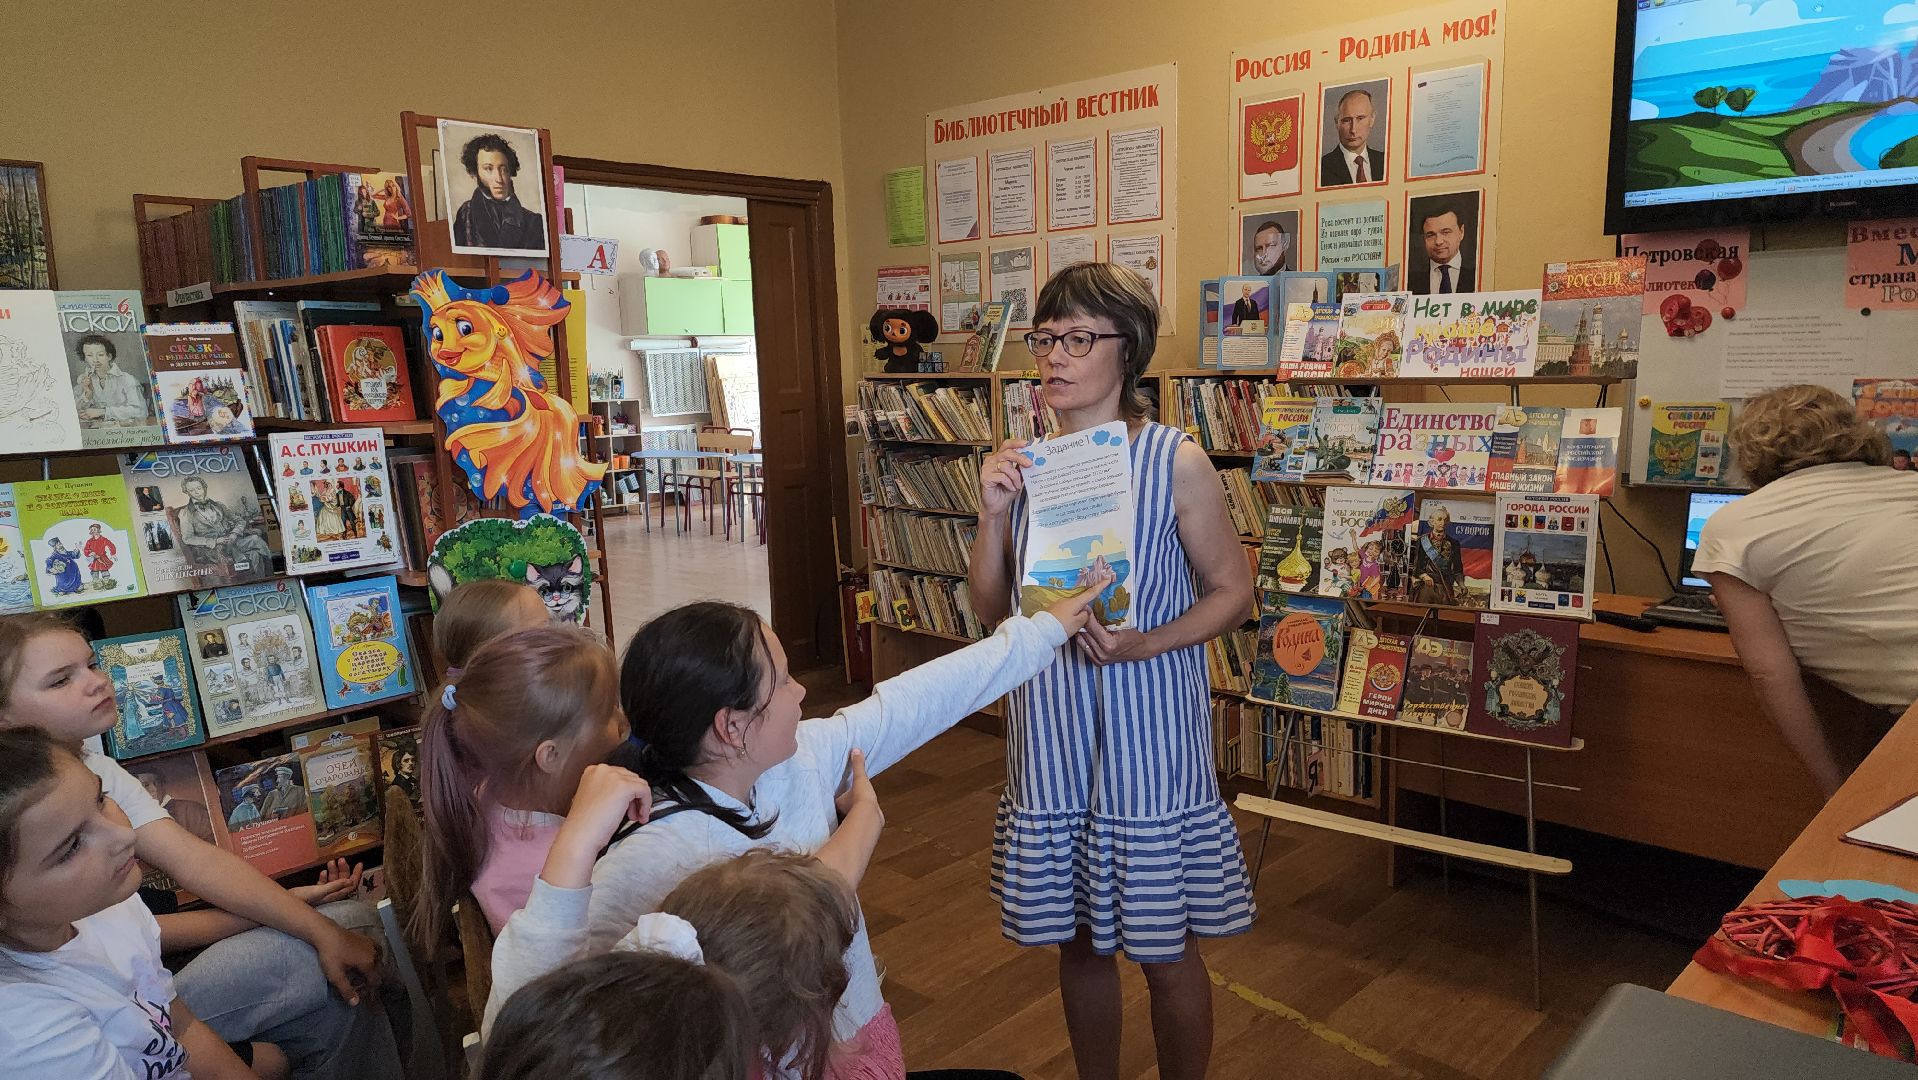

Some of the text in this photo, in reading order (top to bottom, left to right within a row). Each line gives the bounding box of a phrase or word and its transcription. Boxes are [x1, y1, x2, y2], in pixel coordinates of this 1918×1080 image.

[1235, 49, 1311, 82] РОССИЯ
[1339, 27, 1431, 63] РОДИНА
[1442, 8, 1497, 45] МОЯ!
[934, 83, 1159, 144] БИБЛИОТЕЧНЫЙ ВЕСТНИК
[587, 245, 609, 270] А
[1566, 270, 1621, 289] РОССИЯ
[1849, 271, 1916, 288] страна
[1413, 298, 1452, 319] Нет
[1460, 301, 1475, 318] в
[1481, 298, 1538, 322] мире
[169, 343, 222, 353] СКАЗКА
[1460, 362, 1517, 378] нашей
[1385, 407, 1496, 433] Единство
[1045, 434, 1090, 456] Задание 1
[1377, 431, 1493, 456] разных
[1491, 471, 1553, 482] ГЛАВНЫЙ ЗАКОН
[1489, 481, 1545, 492] НАШЕЙ ЖИЗНИ
[1271, 506, 1293, 515] ТВОЯ
[1506, 503, 1590, 514] ГОРОДА РОССИИ
[1455, 525, 1490, 536] СУВОРОВ
[1276, 627, 1320, 655] Родина
[1362, 699, 1396, 710] МИРНЫХ
[1368, 692, 1393, 702] ГЕРОИ
[1367, 708, 1388, 716] ДНЕЙ
[326, 757, 358, 774] ОЧЕЙ
